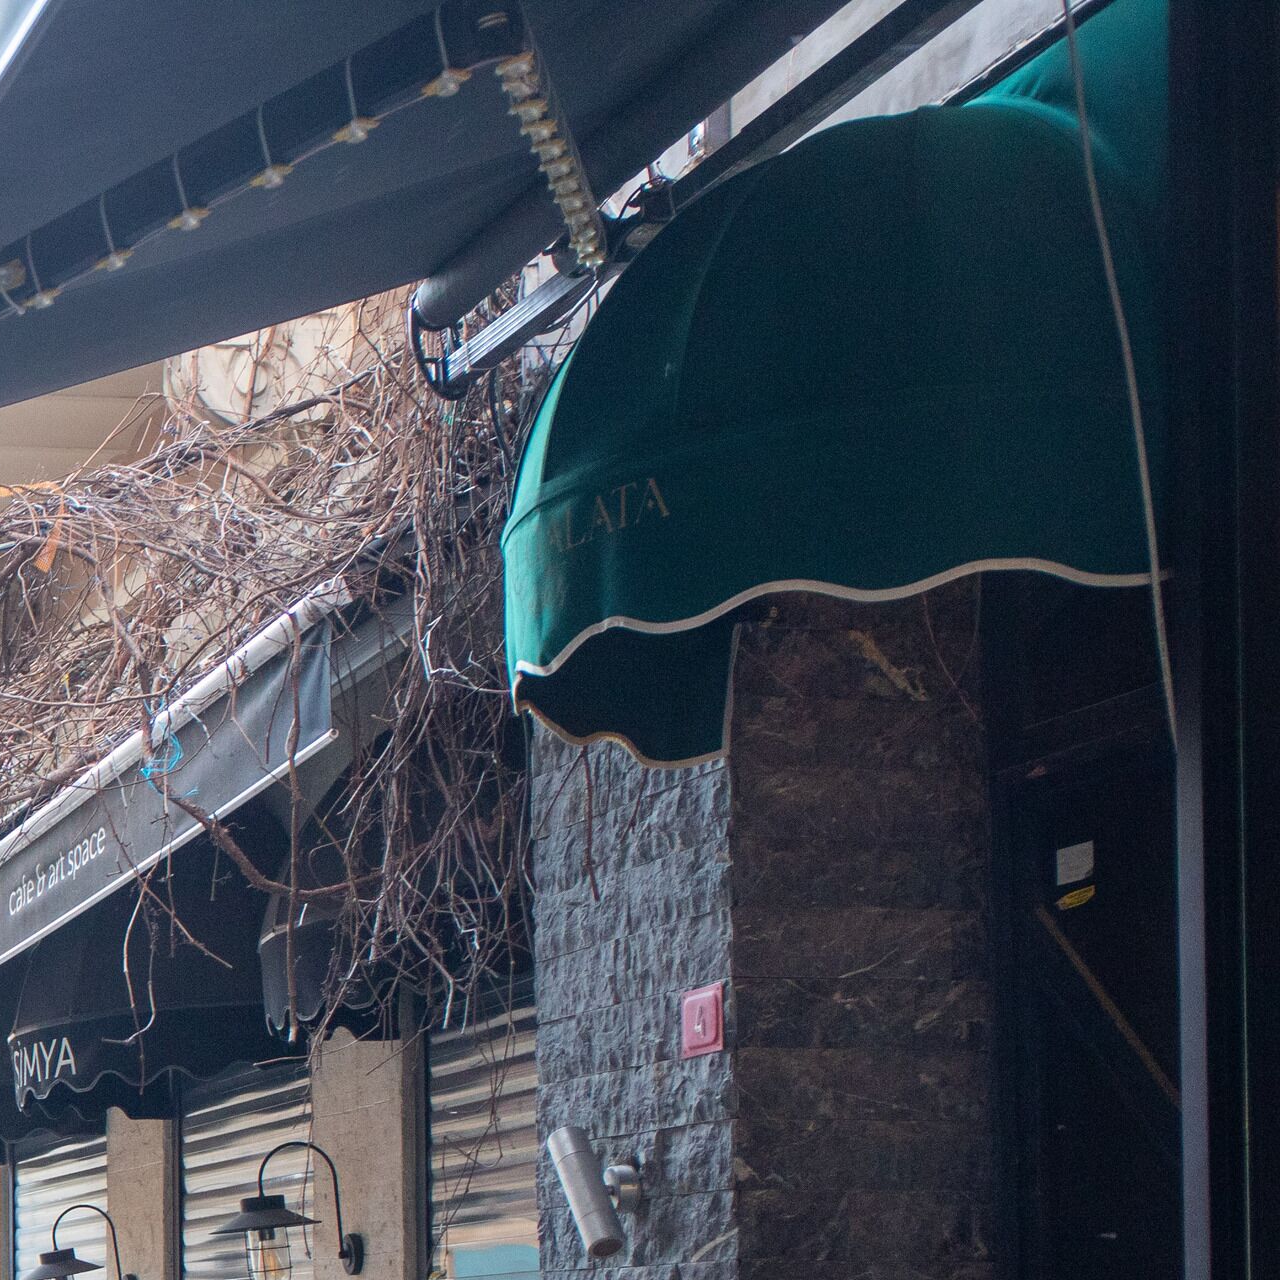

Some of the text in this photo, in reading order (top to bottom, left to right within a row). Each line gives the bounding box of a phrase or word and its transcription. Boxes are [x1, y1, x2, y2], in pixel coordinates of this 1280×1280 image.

[8, 874, 35, 916] cafe
[47, 851, 66, 890] art
[67, 826, 107, 881] space
